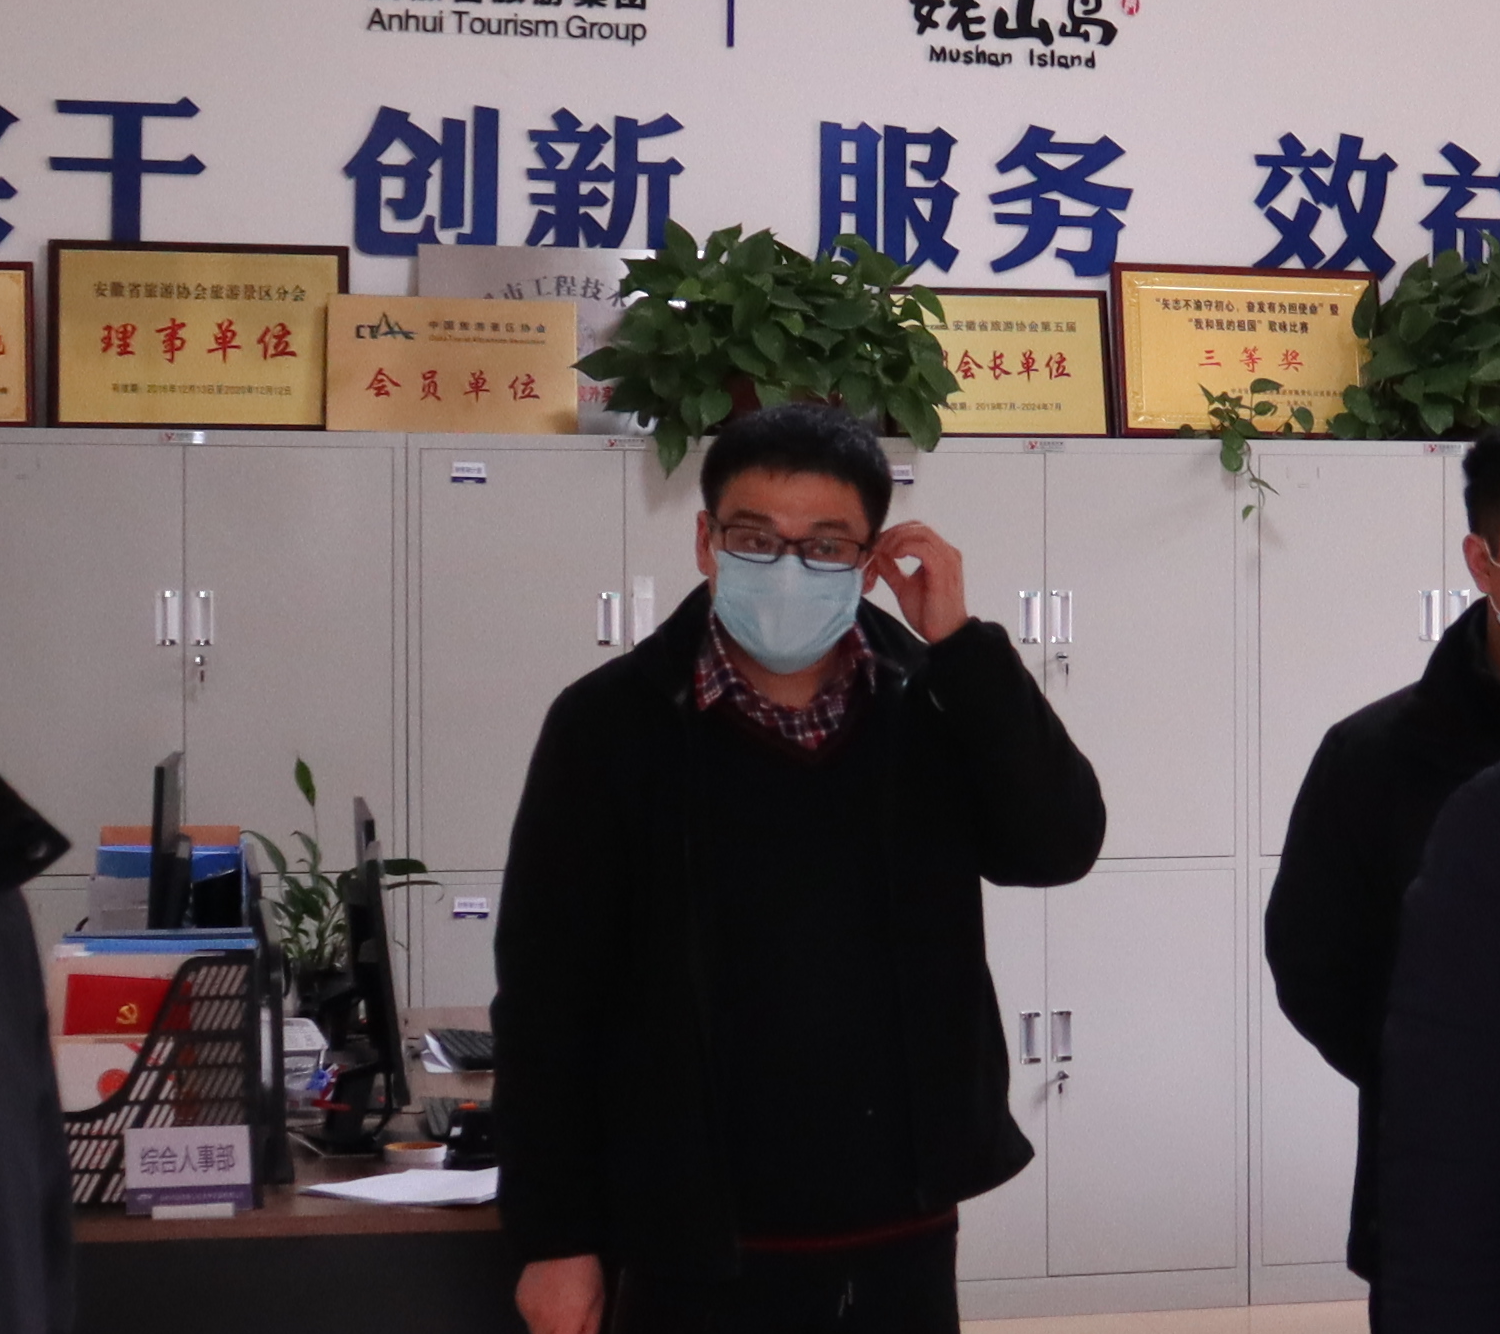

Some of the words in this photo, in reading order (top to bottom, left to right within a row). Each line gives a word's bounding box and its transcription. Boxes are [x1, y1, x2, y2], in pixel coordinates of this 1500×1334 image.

[367, 9, 444, 34] Anhui
[453, 11, 559, 38] Tourism
[566, 15, 647, 46] Group
[929, 44, 1013, 67] Mushan
[1029, 48, 1096, 69] Island
[344, 103, 684, 256] 创新
[817, 121, 1134, 277] 服务
[93, 281, 307, 302] 安徽省旅游协会旅游景区分会
[100, 318, 298, 364] 理事单位
[953, 320, 1077, 333] 安徽省旅游协会第五届
[1199, 346, 1304, 373] 三等奖
[366, 368, 540, 402] 会员单位
[140, 1144, 236, 1175] 综合人事部
